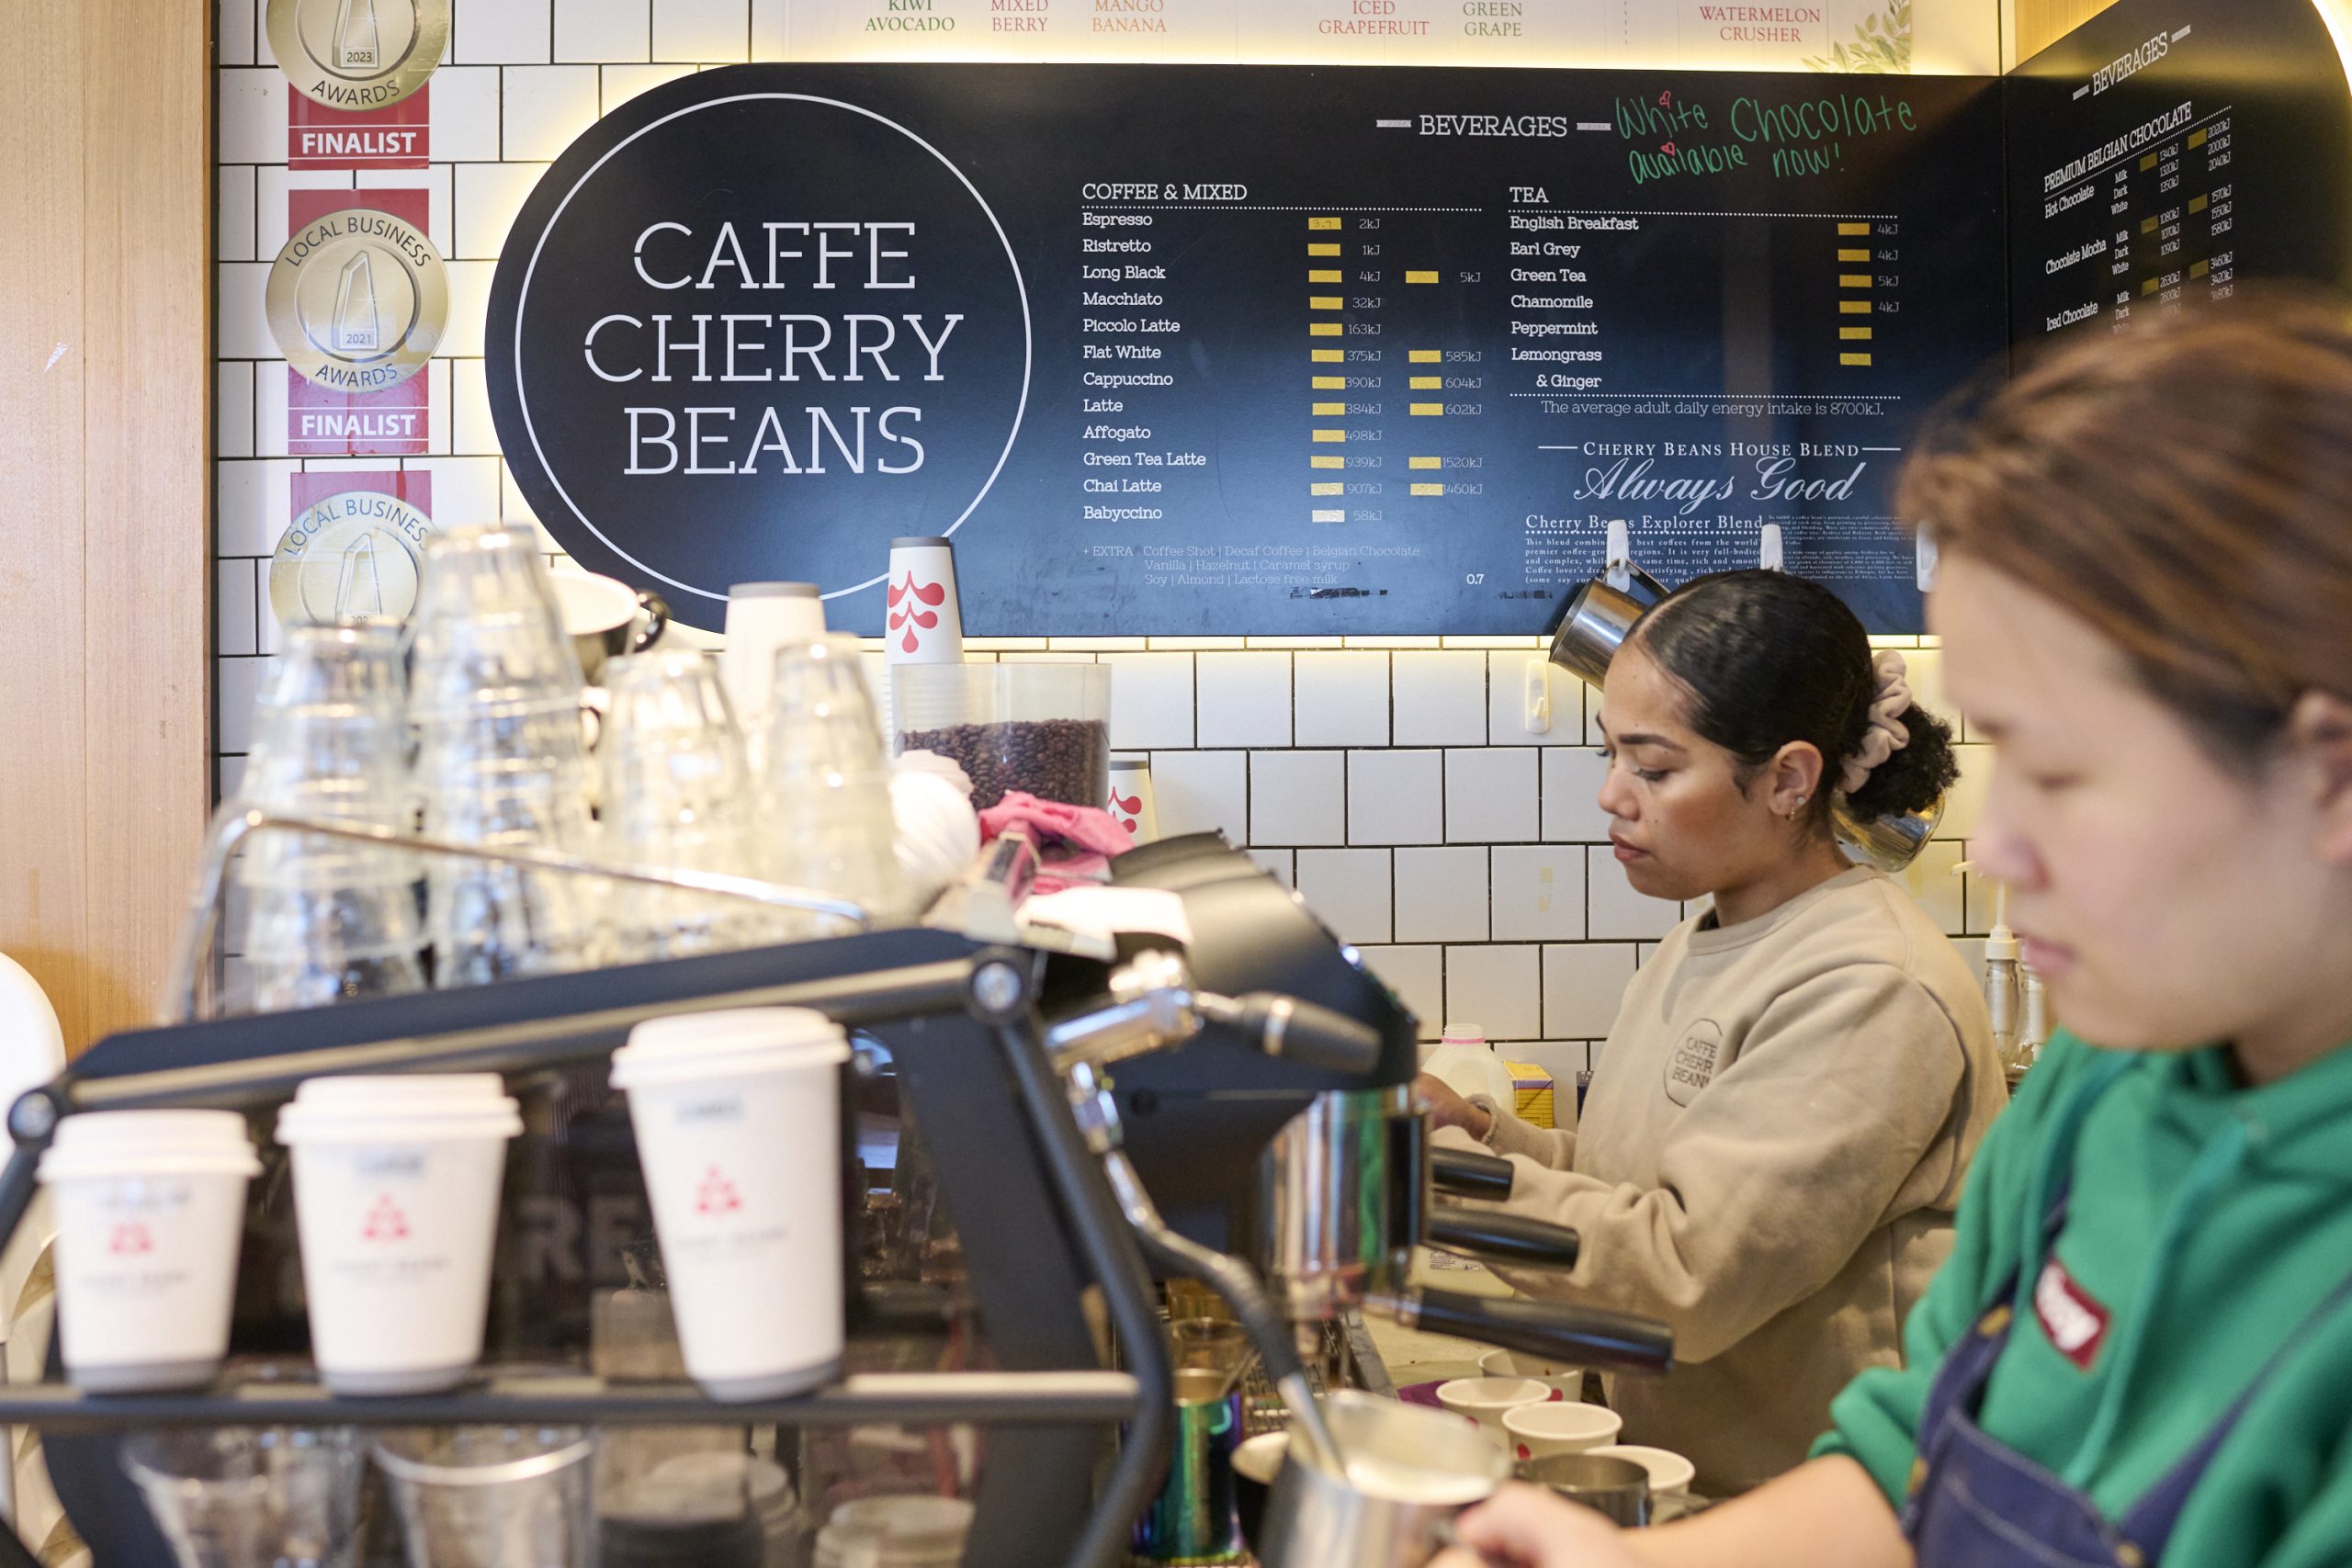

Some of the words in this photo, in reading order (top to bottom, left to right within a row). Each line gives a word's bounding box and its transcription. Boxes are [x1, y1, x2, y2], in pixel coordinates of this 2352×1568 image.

[889, 0, 931, 10] KIWI
[992, 0, 1048, 11] MIXED
[1096, 0, 1163, 12] MANGO
[1353, 1, 1395, 14] ICED
[1464, 2, 1521, 16] GREEN
[1700, 6, 1820, 22] WATERMELON
[865, 17, 955, 30] AVOCADO
[993, 17, 1047, 31] BERRY
[1093, 17, 1166, 32] BANANA
[1319, 20, 1430, 35] GRAPEFRUIT
[1464, 22, 1521, 36] GRAPE
[1720, 27, 1801, 41] CRUSHER
[347, 52, 372, 62] 2023
[2092, 31, 2167, 96] BEVERAGES
[311, 79, 401, 106] AWARDS
[1616, 97, 1709, 141] White
[1732, 95, 1917, 142] Chocolate
[1419, 115, 1566, 137] BEVERAGES
[302, 132, 416, 154] FINALIST
[2044, 156, 2086, 192] PREMIUM
[2087, 133, 2129, 170] BELGIAN
[2130, 101, 2192, 148] CHOCOLATE
[1629, 143, 1747, 185] available
[1773, 142, 1845, 177] now!
[2115, 170, 2128, 184] Milk
[1083, 184, 1158, 199] COFFEE
[1164, 184, 1178, 199] &
[1183, 185, 1247, 199] MIXED
[1510, 187, 1549, 203] TEA
[2113, 186, 2128, 198] Dark
[2045, 197, 2059, 219] Hot
[2059, 185, 2095, 211] Chocolate
[2111, 200, 2128, 215] White
[1082, 212, 1152, 228] Espresso
[1360, 219, 1380, 229] 2kJ
[1510, 216, 1565, 231] English
[1567, 217, 1639, 230] Breakfast
[1878, 224, 1898, 234] 4kJ
[285, 221, 343, 266] LOCAL
[348, 217, 431, 268] BUSINESS
[2116, 231, 2129, 244] Milk
[1083, 239, 1151, 252] Ristretto
[1363, 245, 1380, 254] 1kJ
[1510, 243, 1540, 254] Earl
[1544, 243, 1580, 258] Grey
[2114, 245, 2129, 259] Dark
[634, 222, 915, 289] CAFFE
[1878, 250, 1898, 260] 4kJ
[2045, 249, 2080, 275] Chocolate
[2081, 239, 2106, 260] Mocha
[1083, 265, 1120, 281] Long
[1125, 265, 1166, 278] Black
[1510, 268, 1556, 281] Green
[1559, 269, 1587, 282] Tea
[2112, 261, 2129, 276] White
[1360, 272, 1380, 281] 4kJ
[1461, 272, 1480, 282] 5kJ
[1879, 276, 1898, 287] 5kJ
[1083, 292, 1162, 305] Macchiato
[1352, 298, 1380, 308] 32kJ
[1511, 295, 1593, 308] Chamomile
[2117, 291, 2129, 305] Milk
[1879, 302, 1899, 312] 4kJ
[2115, 307, 2129, 321] Dark
[2046, 312, 2062, 332] Iced
[2063, 302, 2098, 326] Chocolate
[1083, 319, 1136, 332] Piccolo
[1141, 319, 1180, 332] Latte
[1349, 324, 1380, 334] 163kJ
[1511, 321, 1598, 337] Peppermint
[346, 334, 370, 344] 2021
[585, 314, 964, 382] CHERRY
[1083, 345, 1112, 358] Flat
[1115, 345, 1161, 358] White
[1348, 351, 1381, 361] 375kJ
[1446, 352, 1481, 362] 585kJ
[1511, 348, 1601, 364] Lemongrass
[316, 363, 397, 387] AWARDS
[1083, 372, 1173, 388] Cappuccino
[1343, 377, 1381, 388] 390kJ
[1446, 378, 1481, 388] 604kJ
[1536, 375, 1548, 387] &
[1551, 375, 1601, 390] Ginger
[1084, 399, 1123, 412] Latte
[1346, 404, 1381, 414] 384kJ
[1446, 404, 1482, 414] 602kJ
[1541, 400, 1568, 412] The
[1572, 404, 1631, 416] average
[1634, 401, 1671, 413] adult
[1675, 401, 1709, 417] daily
[1713, 405, 1764, 417] energy
[1768, 402, 1811, 414] intake
[1815, 403, 1826, 414] is
[1830, 402, 1883, 415] 8700kJ.
[301, 415, 415, 435] FINALIST
[624, 407, 924, 474] BEANS
[1083, 425, 1150, 442] Affogato
[1345, 431, 1381, 441] 498kJ
[1584, 442, 1656, 455] CHERRY
[1665, 443, 1721, 456] BEANS
[1731, 443, 1791, 456] HOUSE
[1801, 443, 1858, 456] BLEND
[1084, 453, 1132, 465] Green
[1135, 453, 1163, 465] Tea
[1167, 453, 1206, 465] Latte
[1346, 457, 1382, 468] 939kJ
[1084, 479, 1118, 491] Chai
[1121, 479, 1161, 491] Latte
[1348, 484, 1382, 493] 907kJ
[1574, 457, 1735, 515] Always
[1751, 457, 1866, 501] Good
[1084, 506, 1162, 522] Babyccino
[1353, 510, 1382, 521] 58kJ
[284, 504, 340, 556] LOCAL
[1526, 515, 1581, 534] Cherry
[1589, 515, 1634, 528] Bes
[1643, 515, 1710, 535] Explorer
[1718, 515, 1762, 528] Blend
[1524, 537, 1543, 546] This
[1546, 537, 1570, 546] blend
[1658, 538, 1687, 547] coffees
[1691, 538, 1712, 547] from
[1716, 537, 1730, 546] the
[1093, 547, 1133, 556] EXTRA
[1144, 547, 1183, 556] Coffee
[1187, 546, 1216, 556] Shot
[1226, 546, 1260, 556] Decaf
[1263, 546, 1303, 556] Coffee
[1313, 546, 1356, 558] Belgian
[1360, 546, 1419, 556] Chocolate
[1145, 560, 1185, 570] Vanilla
[1197, 560, 1250, 570] Hazelnut
[1260, 559, 1310, 570] Caramel
[1315, 562, 1349, 572] syrup
[1145, 574, 1167, 586] Soy
[1178, 574, 1224, 584] Almond
[1235, 573, 1281, 584] Lactose
[1284, 574, 1309, 583] free
[1313, 574, 1338, 583] milk
[1467, 574, 1484, 584] 0.7
[1686, 1037, 1717, 1059] CAFFE
[1676, 1051, 1713, 1075] CHERR
